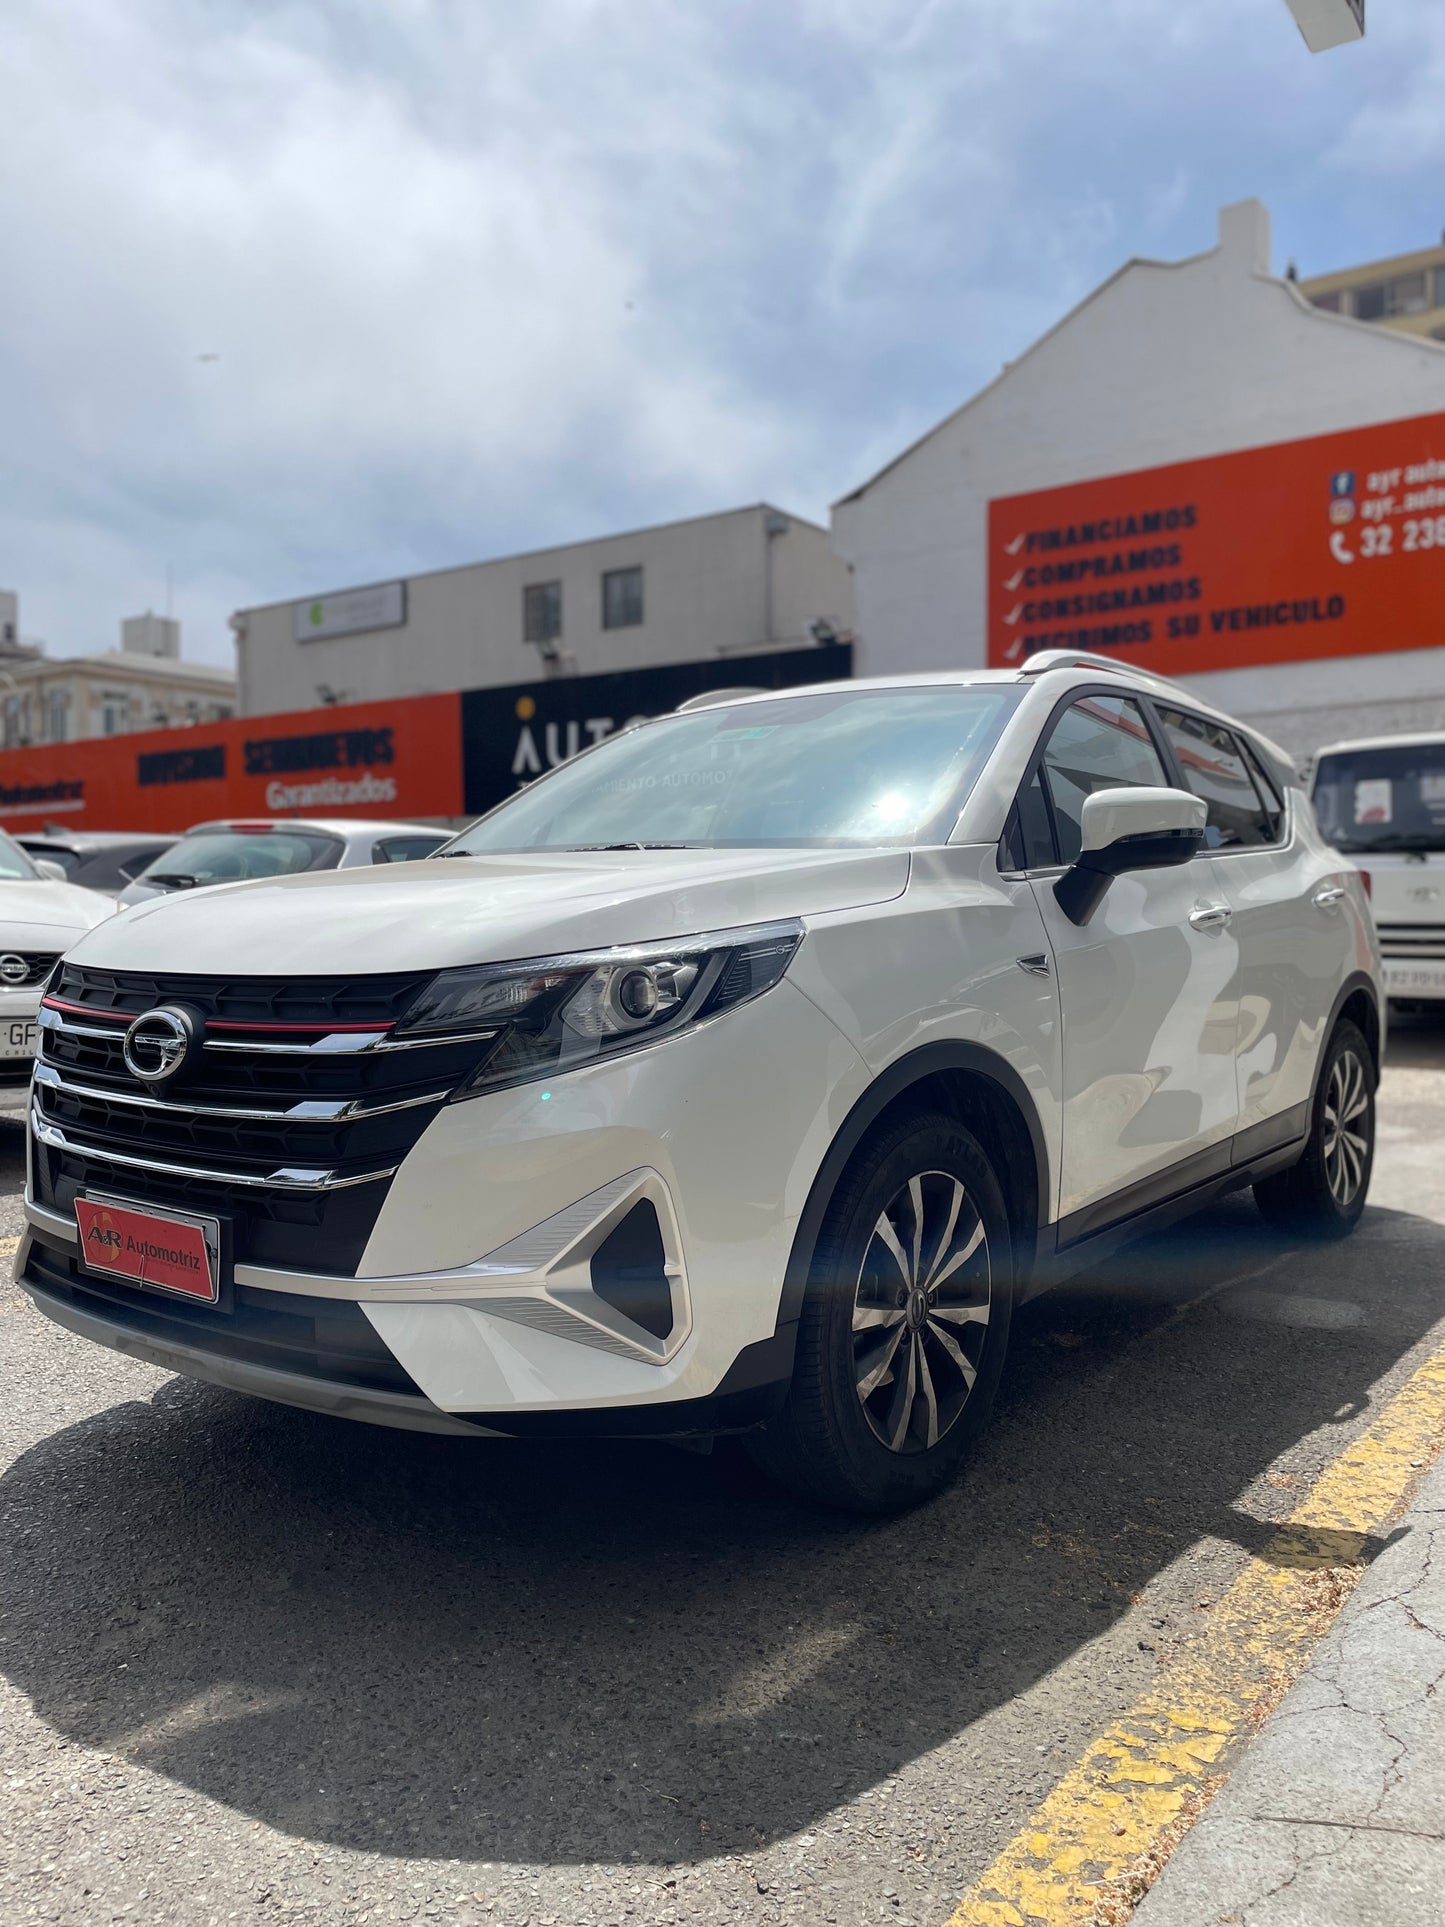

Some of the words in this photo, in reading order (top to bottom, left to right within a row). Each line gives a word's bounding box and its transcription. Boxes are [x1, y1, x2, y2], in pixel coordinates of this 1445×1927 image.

[1366, 467, 1402, 494] ayr
[1025, 505, 1197, 554] FINANCIAMOS
[1360, 524, 1393, 558] 32
[1024, 544, 1181, 588] COMPRAMOS
[1023, 577, 1201, 623] CONSIGNAMOS
[1167, 612, 1200, 640] SU
[1210, 595, 1345, 633] VEHICULO
[511, 715, 650, 774] AUT
[265, 771, 397, 811] Garantizados
[127, 1235, 201, 1271] Automotriz
